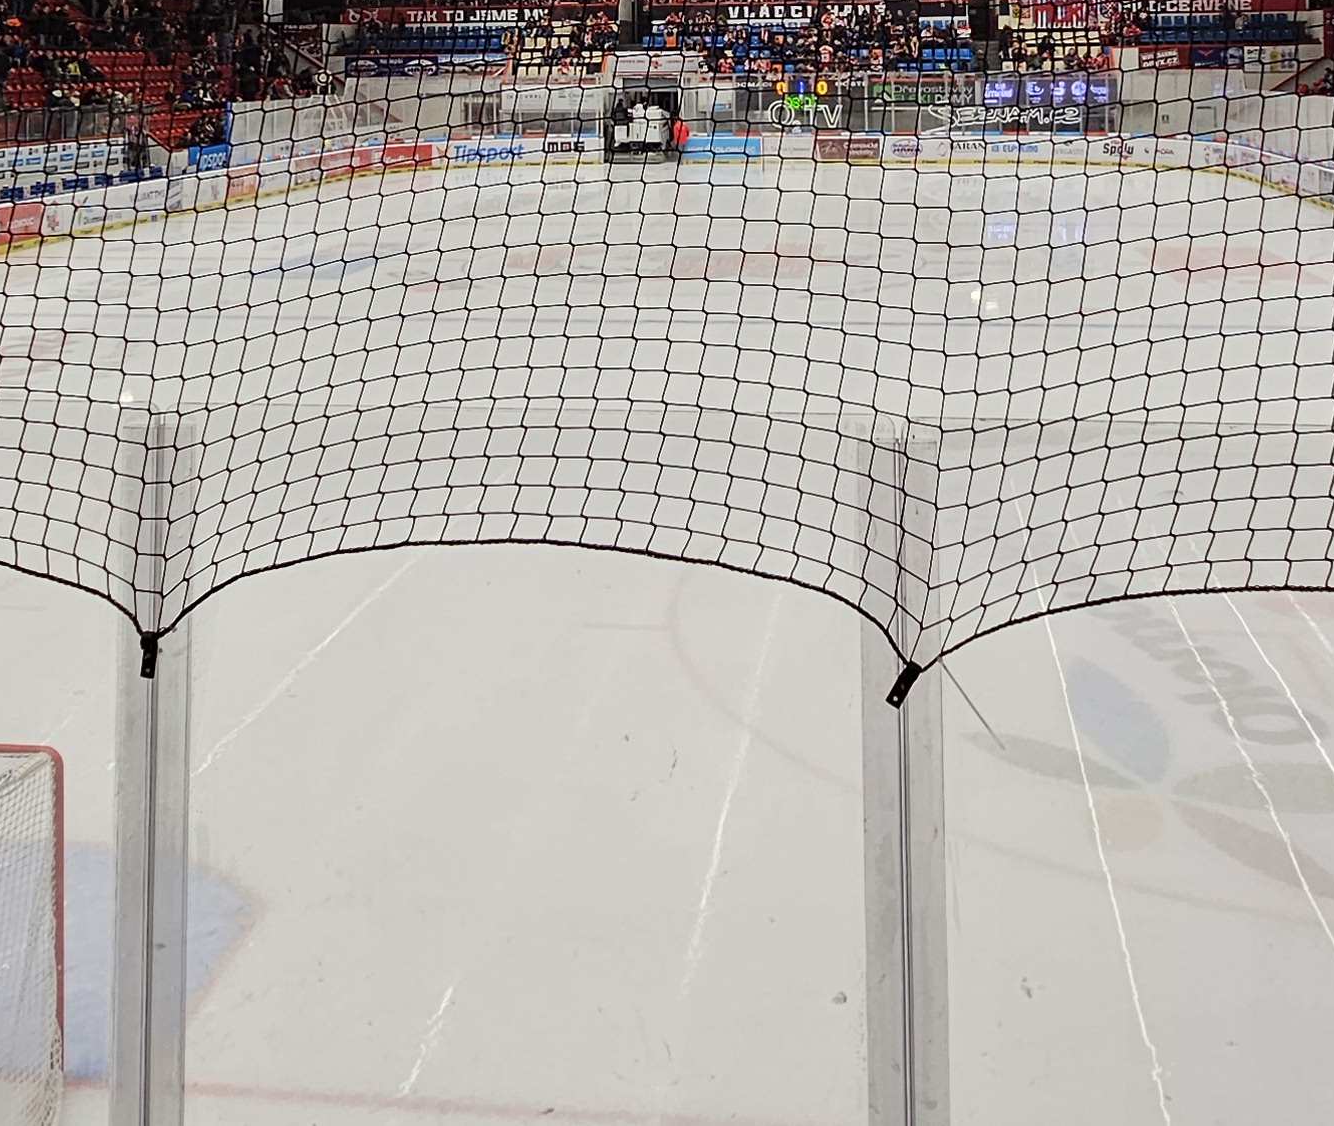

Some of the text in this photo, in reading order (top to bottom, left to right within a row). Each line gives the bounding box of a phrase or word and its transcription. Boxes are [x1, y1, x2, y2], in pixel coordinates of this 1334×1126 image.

[443, 10, 463, 22] TO
[728, 3, 813, 18] VLÁDCI
[454, 143, 524, 162] Tipsport
